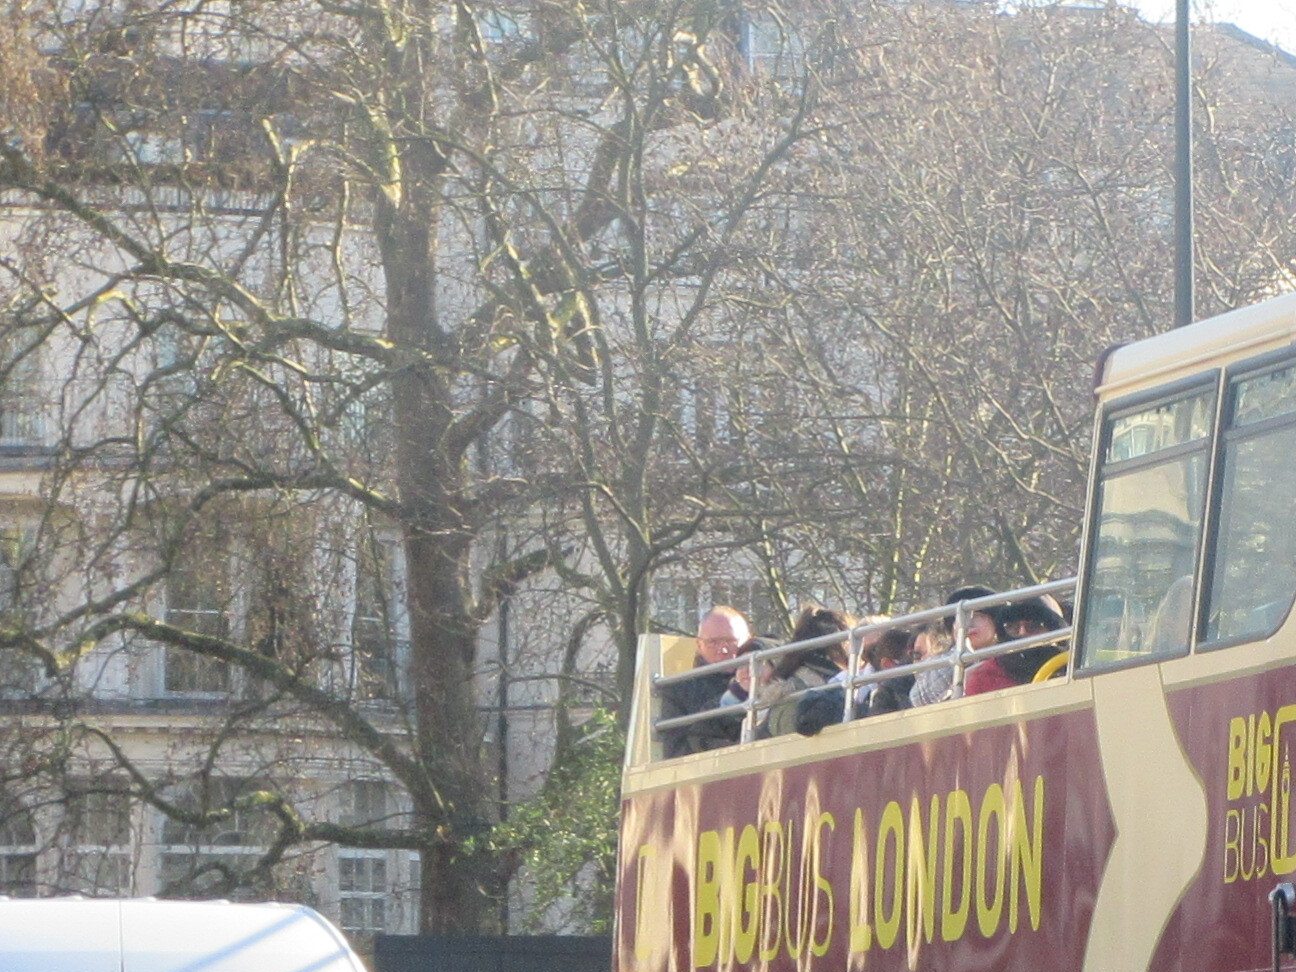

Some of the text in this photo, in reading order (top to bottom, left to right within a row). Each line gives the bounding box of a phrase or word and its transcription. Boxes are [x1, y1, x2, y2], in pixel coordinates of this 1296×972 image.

[1227, 710, 1271, 800] BIG
[849, 775, 1044, 953] LONDON
[1224, 803, 1268, 884] BUS
